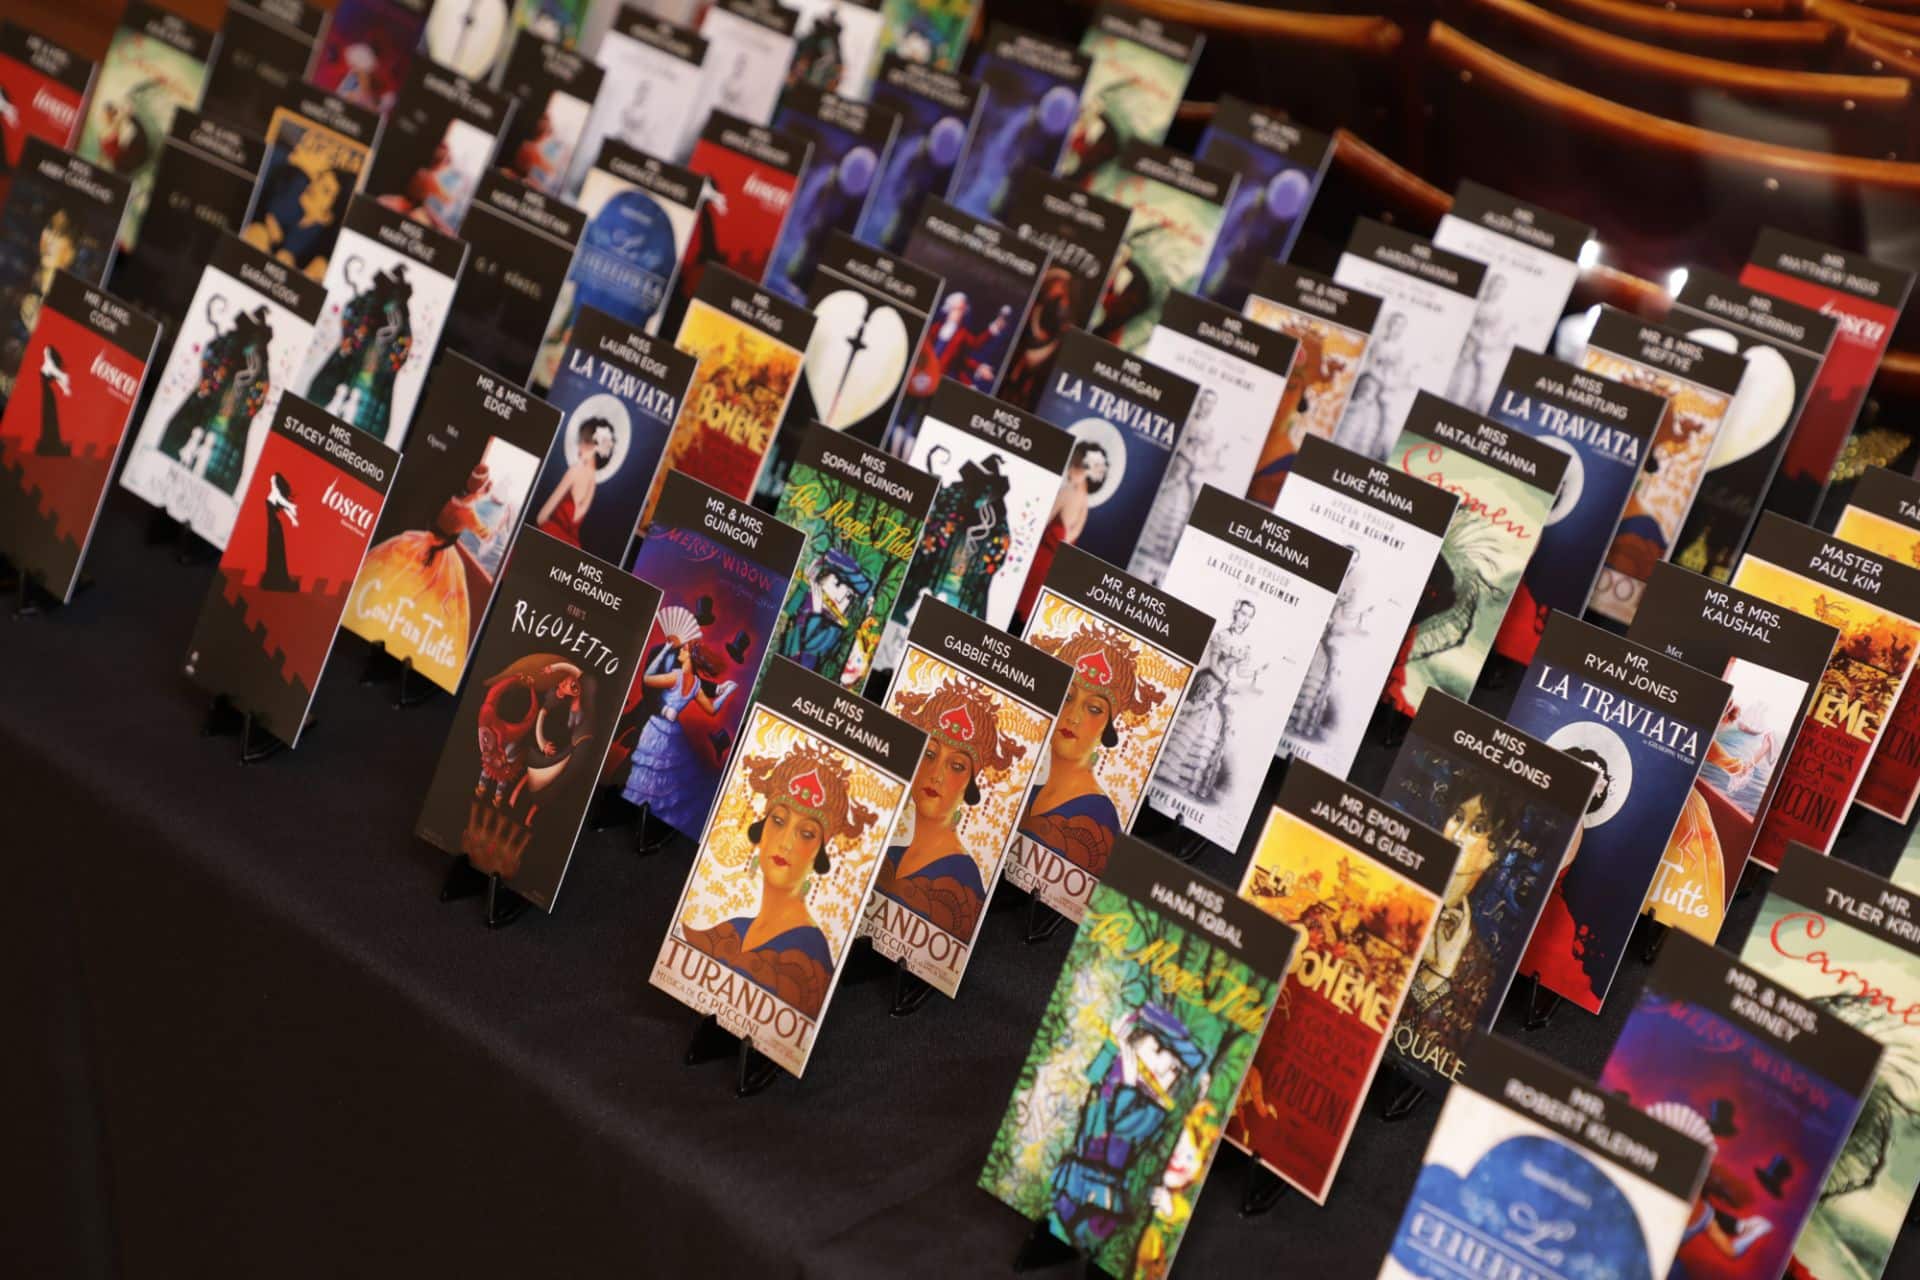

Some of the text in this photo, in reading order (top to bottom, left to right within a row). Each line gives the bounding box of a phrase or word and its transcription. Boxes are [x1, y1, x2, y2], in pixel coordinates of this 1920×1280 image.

[599, 336, 669, 379] LAUREN EDGE
[476, 374, 529, 413] MR. & MRS.
[568, 348, 596, 379] LA
[598, 360, 677, 420] TRAVIATA
[1094, 361, 1162, 402] MAX HAGAN
[1535, 376, 1628, 420] AVA HARTUNG
[483, 394, 512, 420] EDGE
[1055, 372, 1082, 403] LA
[1086, 384, 1178, 447] TRAVIATA
[1501, 390, 1531, 420] LA
[1538, 402, 1641, 460] TRAVIATA
[284, 415, 385, 482] STACEY DIGREGORIO
[328, 423, 353, 445] MRS.
[970, 414, 1034, 452] EMILY GUO
[1434, 421, 1537, 477] NATALIE HANNA
[1477, 424, 1509, 446] MISS
[821, 451, 914, 503] SOPHIA GUINGON
[860, 452, 887, 473] MISS
[1368, 467, 1390, 487] MR.
[321, 477, 375, 530] tosca
[1332, 468, 1413, 514] LUKE HANNA
[704, 514, 759, 549] GUINGON
[706, 496, 764, 536] MR. & MRS.
[1261, 519, 1291, 542] MISS
[1227, 521, 1310, 569] LEILA HANNA
[1820, 543, 1883, 577] MASTER
[550, 566, 623, 611] KIM GRANDE
[577, 561, 604, 585] MRS.
[1809, 556, 1881, 594] PAUL KIM
[1085, 585, 1171, 637] JOHN HANNA
[1101, 573, 1168, 617] MR. & MRS.
[1704, 589, 1782, 629] MR. & MRS.
[1702, 606, 1772, 644] KAUSHAL
[943, 635, 1037, 692] GABBIE HANNA
[982, 633, 1013, 660] MISS
[1624, 651, 1650, 673] MR.
[1584, 653, 1679, 704] RYAN JONES
[792, 696, 891, 758] ASHLEY HANNA
[833, 697, 865, 722] MISS
[1536, 665, 1699, 758] LA TRAVIATA
[1453, 730, 1552, 790] GRACE JONES
[1492, 729, 1527, 756] MISS
[1170, 798, 1205, 824] DANIELE
[1340, 794, 1410, 842] MR. EMON
[1310, 801, 1425, 870] JAVADI & GUEST
[1151, 883, 1243, 949] HANA IQBAL
[1187, 881, 1224, 914] MISS
[1826, 888, 1884, 926] TYLER
[1879, 890, 1911, 918] MR.
[865, 923, 914, 959] PUCCINI
[708, 998, 760, 1036] PUCCINI
[1724, 967, 1818, 1034] MR. & MRS.
[1730, 994, 1800, 1043] KRINEY
[1503, 1076, 1587, 1134] ROBERT
